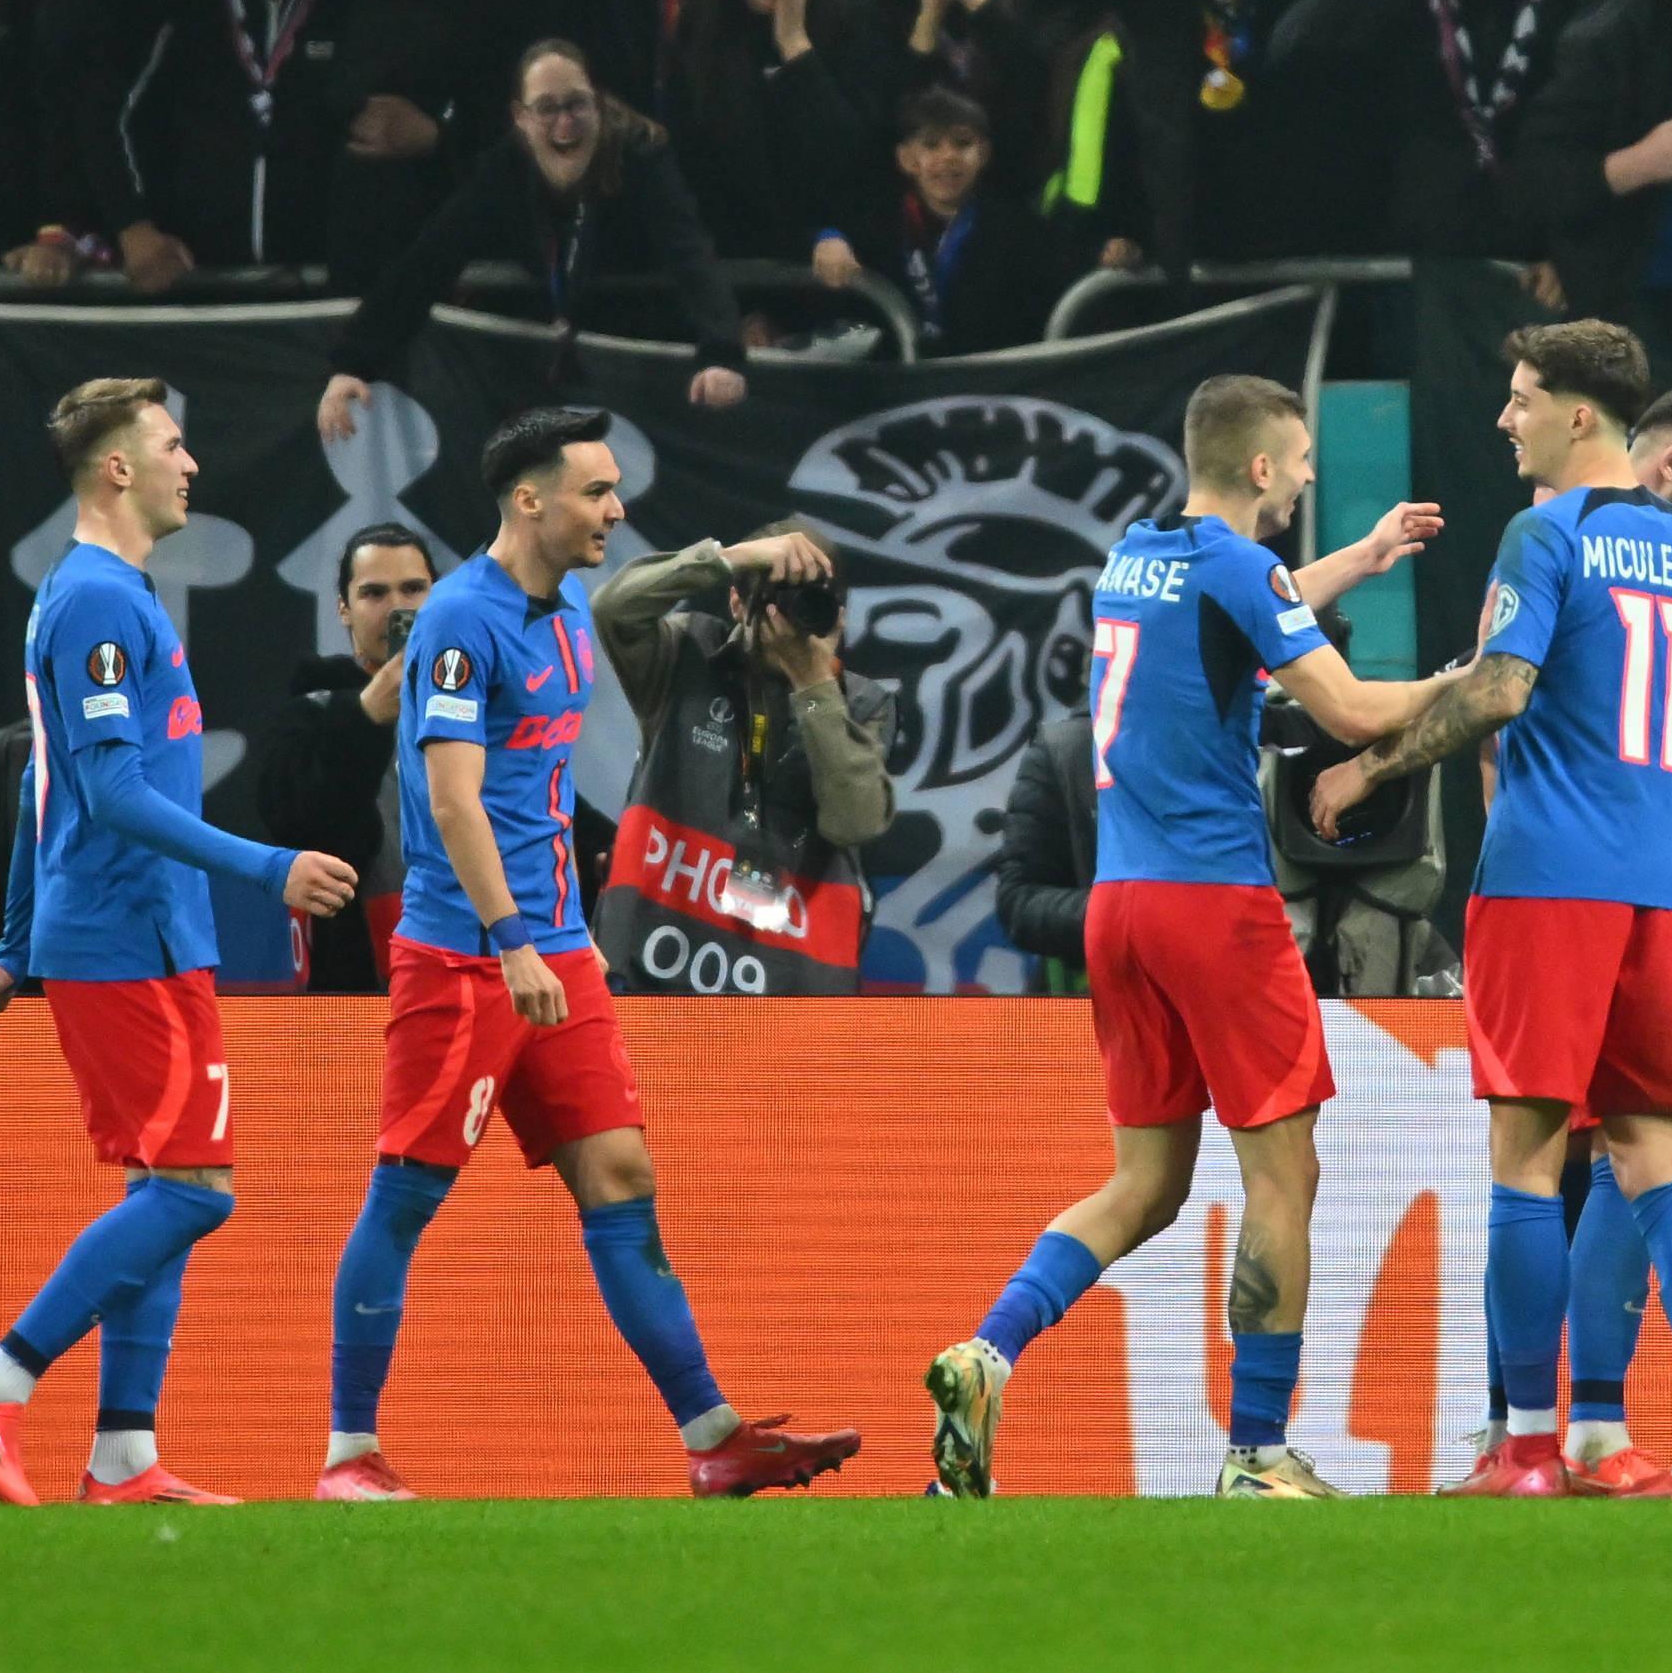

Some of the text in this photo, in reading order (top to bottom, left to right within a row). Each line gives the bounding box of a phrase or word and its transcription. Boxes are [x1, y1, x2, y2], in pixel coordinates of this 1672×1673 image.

[1094, 617, 1140, 789] 7
[645, 824, 810, 940] PHOO
[463, 1076, 495, 1147] 8
